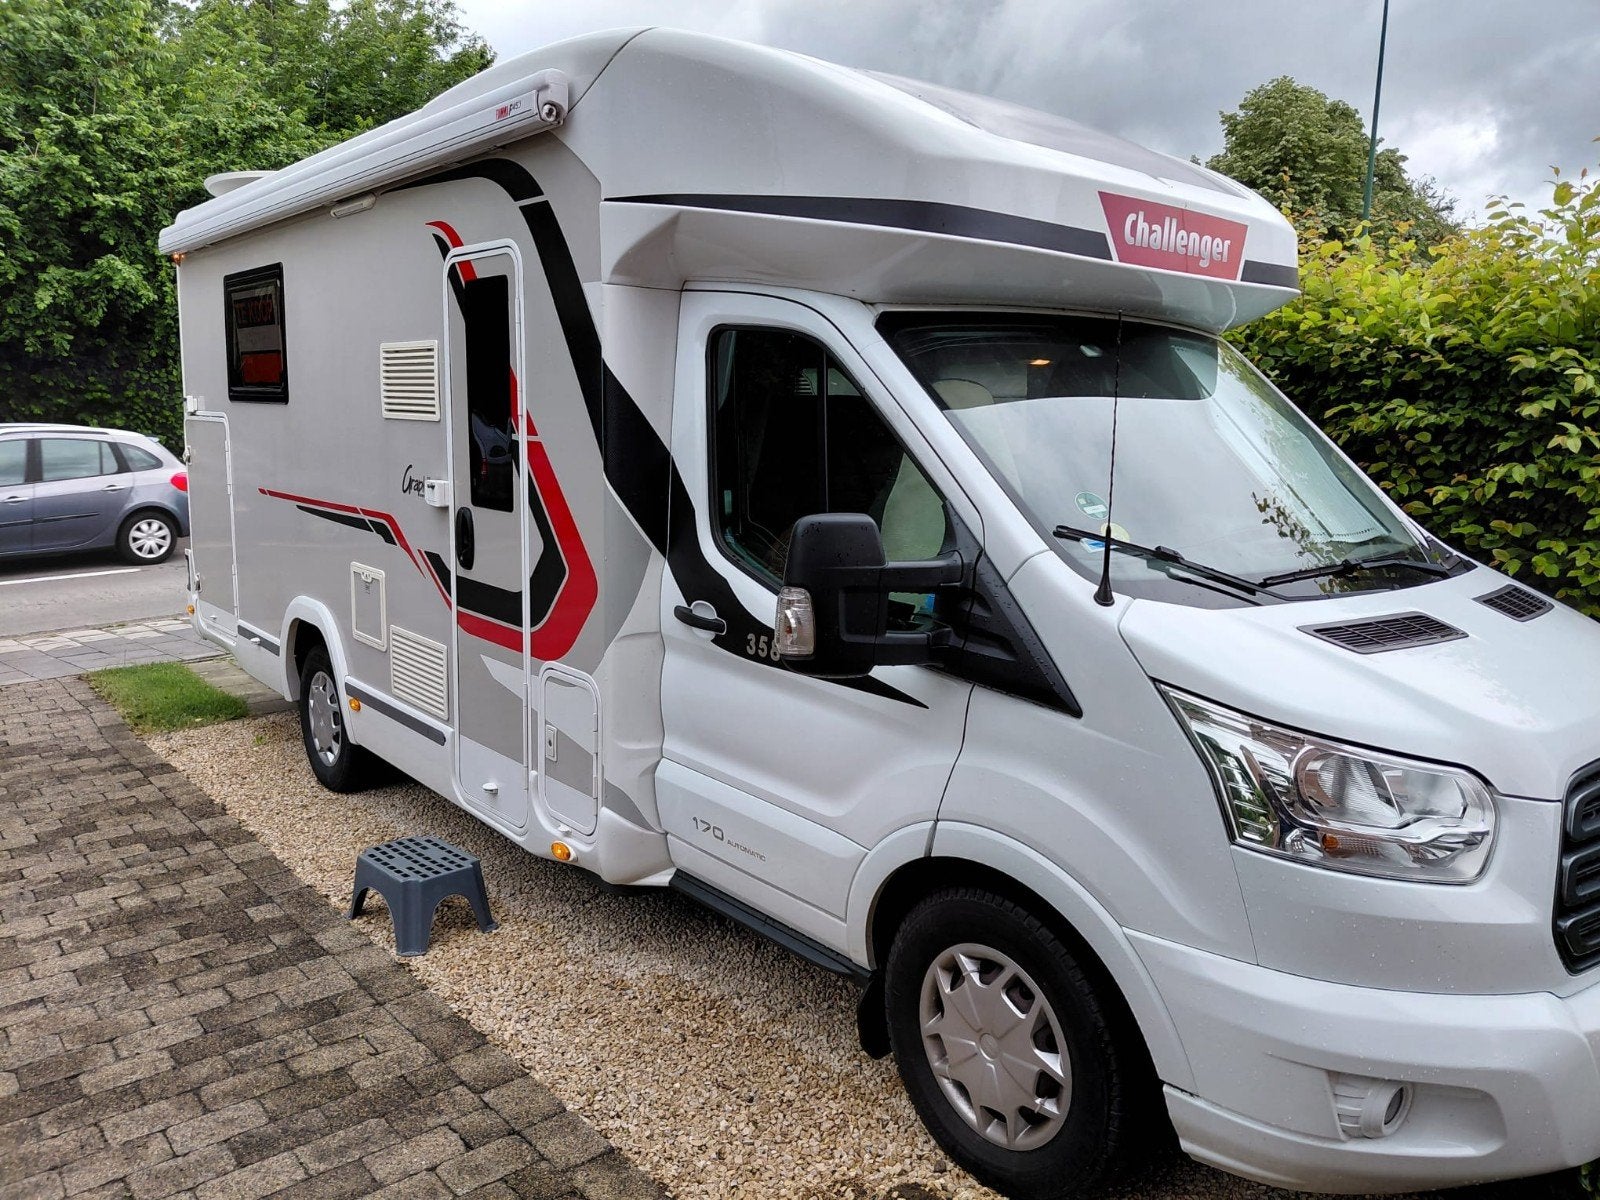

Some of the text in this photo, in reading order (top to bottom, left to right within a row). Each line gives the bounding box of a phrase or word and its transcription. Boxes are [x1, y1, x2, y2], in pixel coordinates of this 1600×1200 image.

[1124, 211, 1231, 268] Challenger
[692, 816, 766, 862] 170 AUTOMATIC
